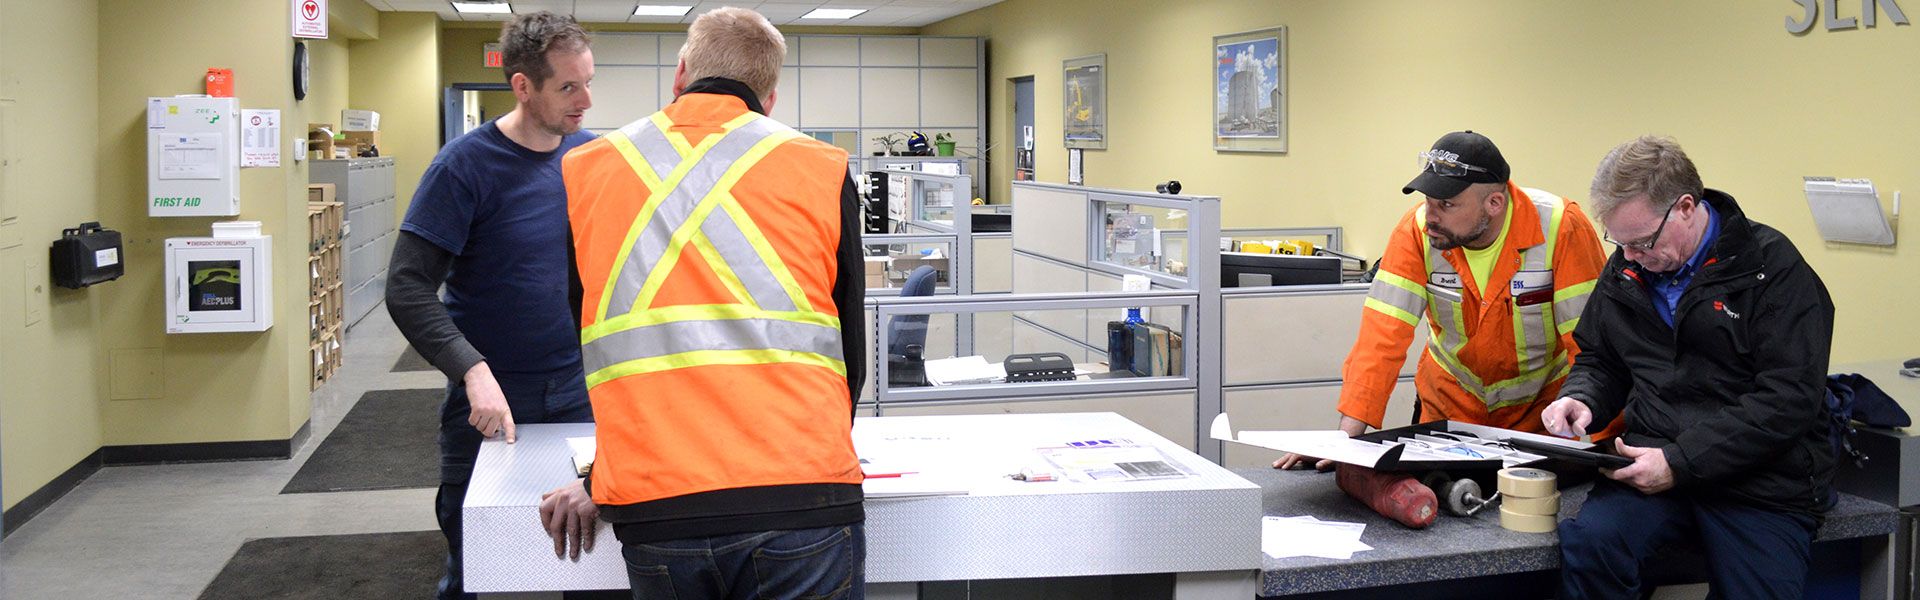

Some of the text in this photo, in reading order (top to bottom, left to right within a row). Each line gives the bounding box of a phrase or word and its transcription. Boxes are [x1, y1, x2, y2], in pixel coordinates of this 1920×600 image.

[487, 51, 503, 66] EXI
[153, 198, 202, 207] FIRST AID
[1513, 280, 1525, 289] ESS
